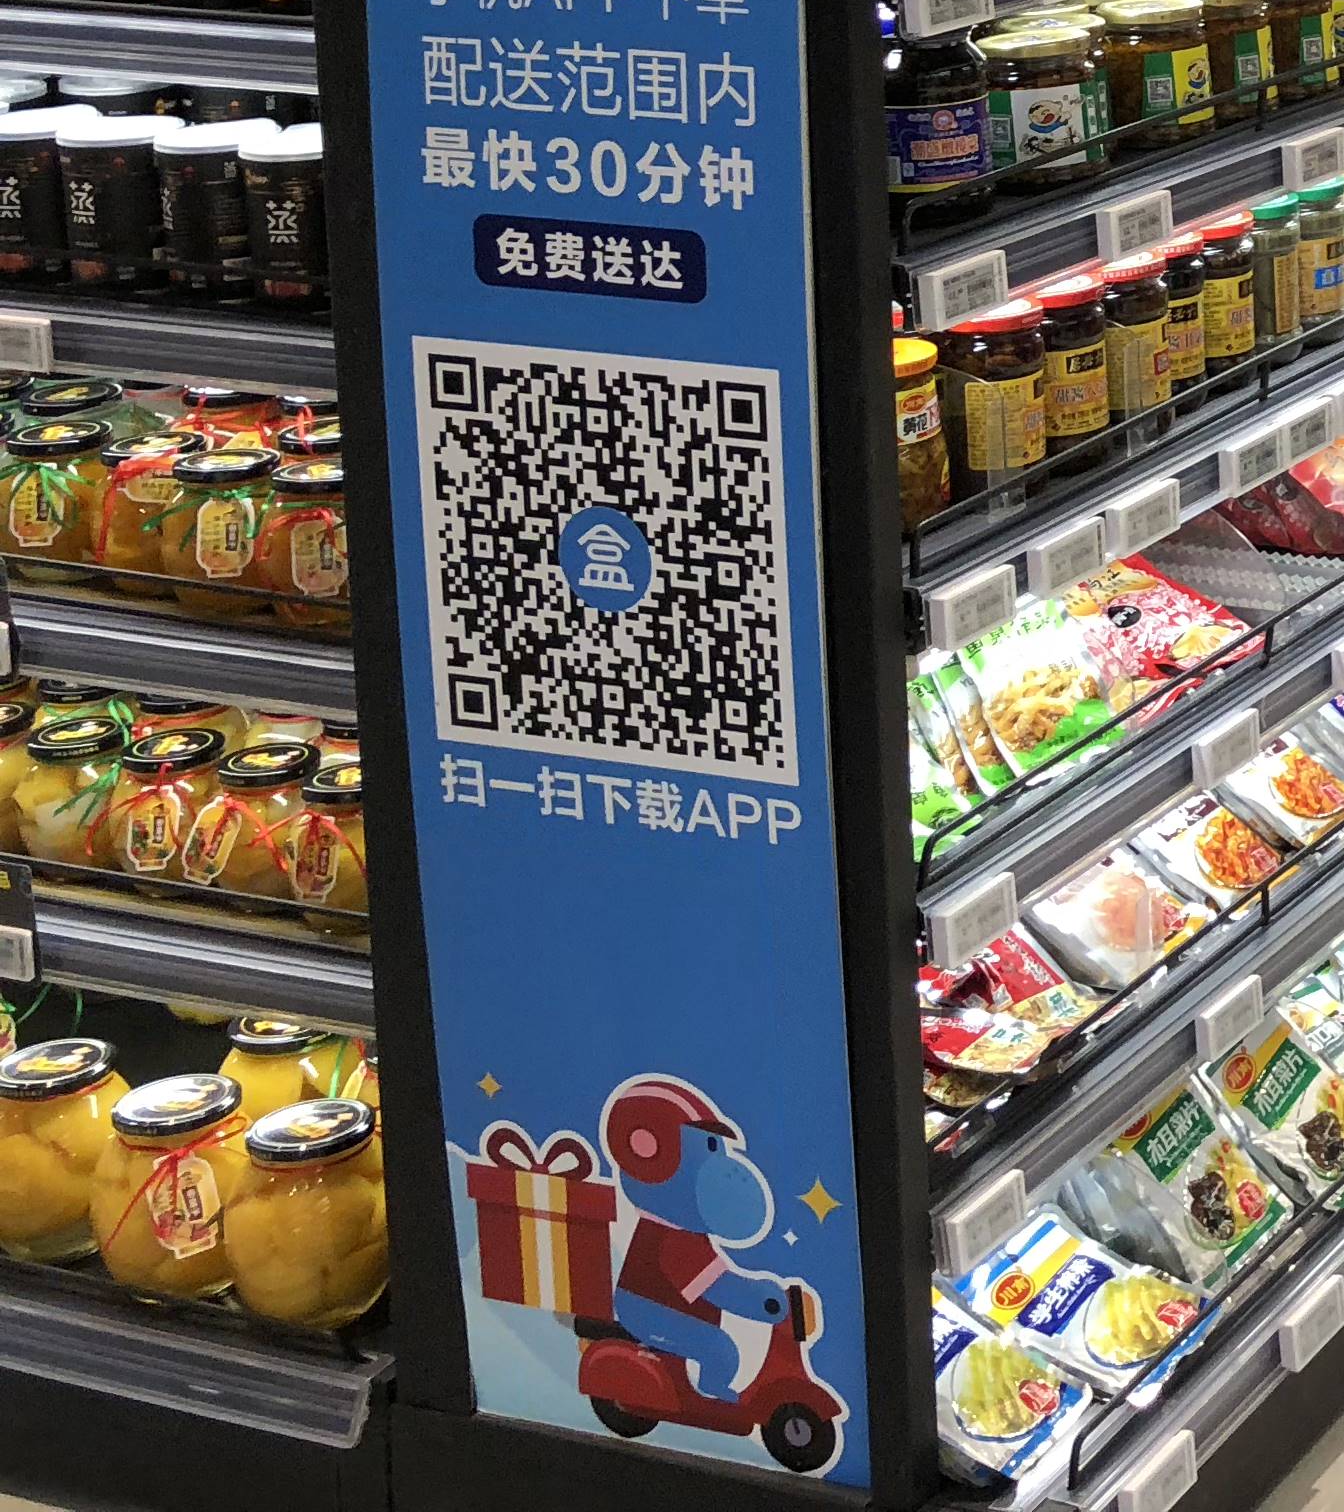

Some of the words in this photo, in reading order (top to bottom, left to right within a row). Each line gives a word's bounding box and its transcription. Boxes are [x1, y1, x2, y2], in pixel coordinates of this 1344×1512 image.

[421, 35, 757, 127] 配送范围内
[421, 126, 755, 211] 最快30分钟
[495, 227, 685, 290] 免费送达
[576, 522, 635, 593] 盒
[440, 752, 802, 846] 扫一扫下载APP
